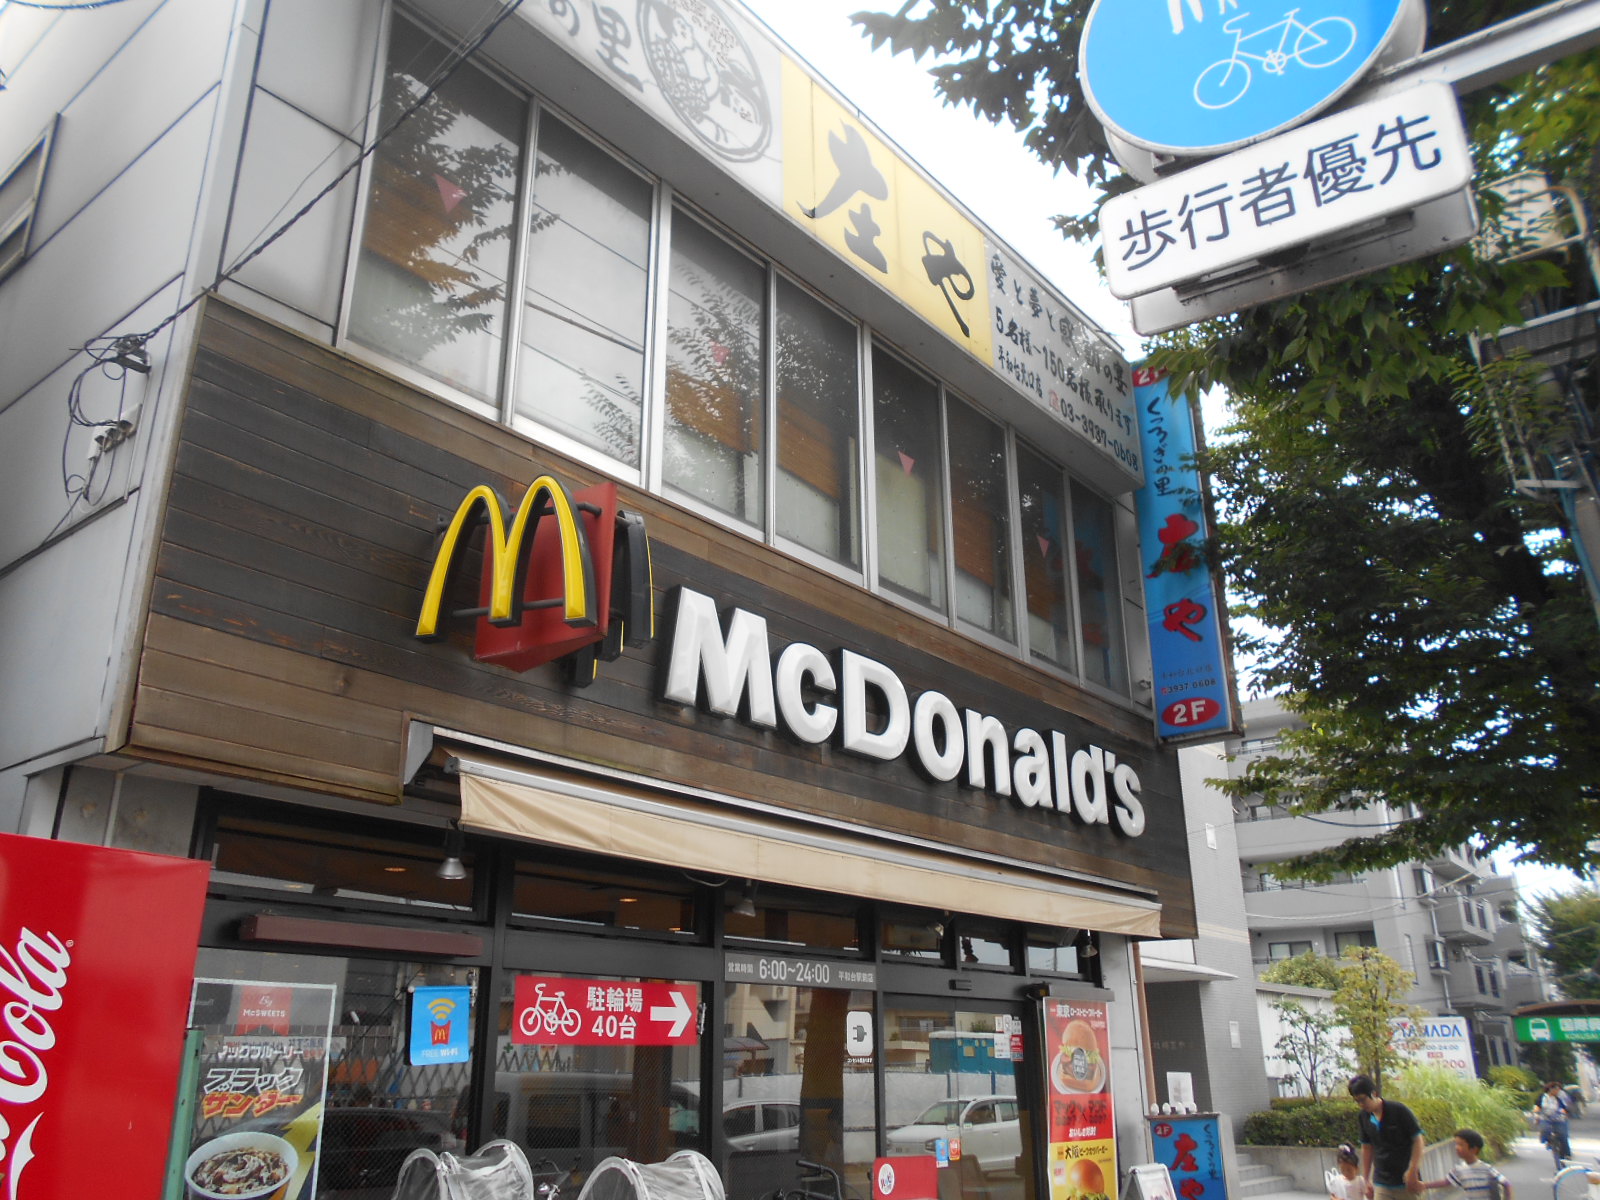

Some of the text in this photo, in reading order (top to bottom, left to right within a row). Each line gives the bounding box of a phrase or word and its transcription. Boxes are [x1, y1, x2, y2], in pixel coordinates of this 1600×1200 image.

[1118, 114, 1443, 272] 歩行者優先
[1060, 398, 1139, 472] 03-3937-0608
[663, 586, 1146, 838] McDonald's
[1173, 699, 1206, 724] 2F
[727, 961, 754, 974] 営業時間
[586, 986, 644, 1012] 駐輪場
[591, 1015, 637, 1040] 40台
[204, 1067, 304, 1096] ブラック
[202, 1090, 304, 1120] サンダー
